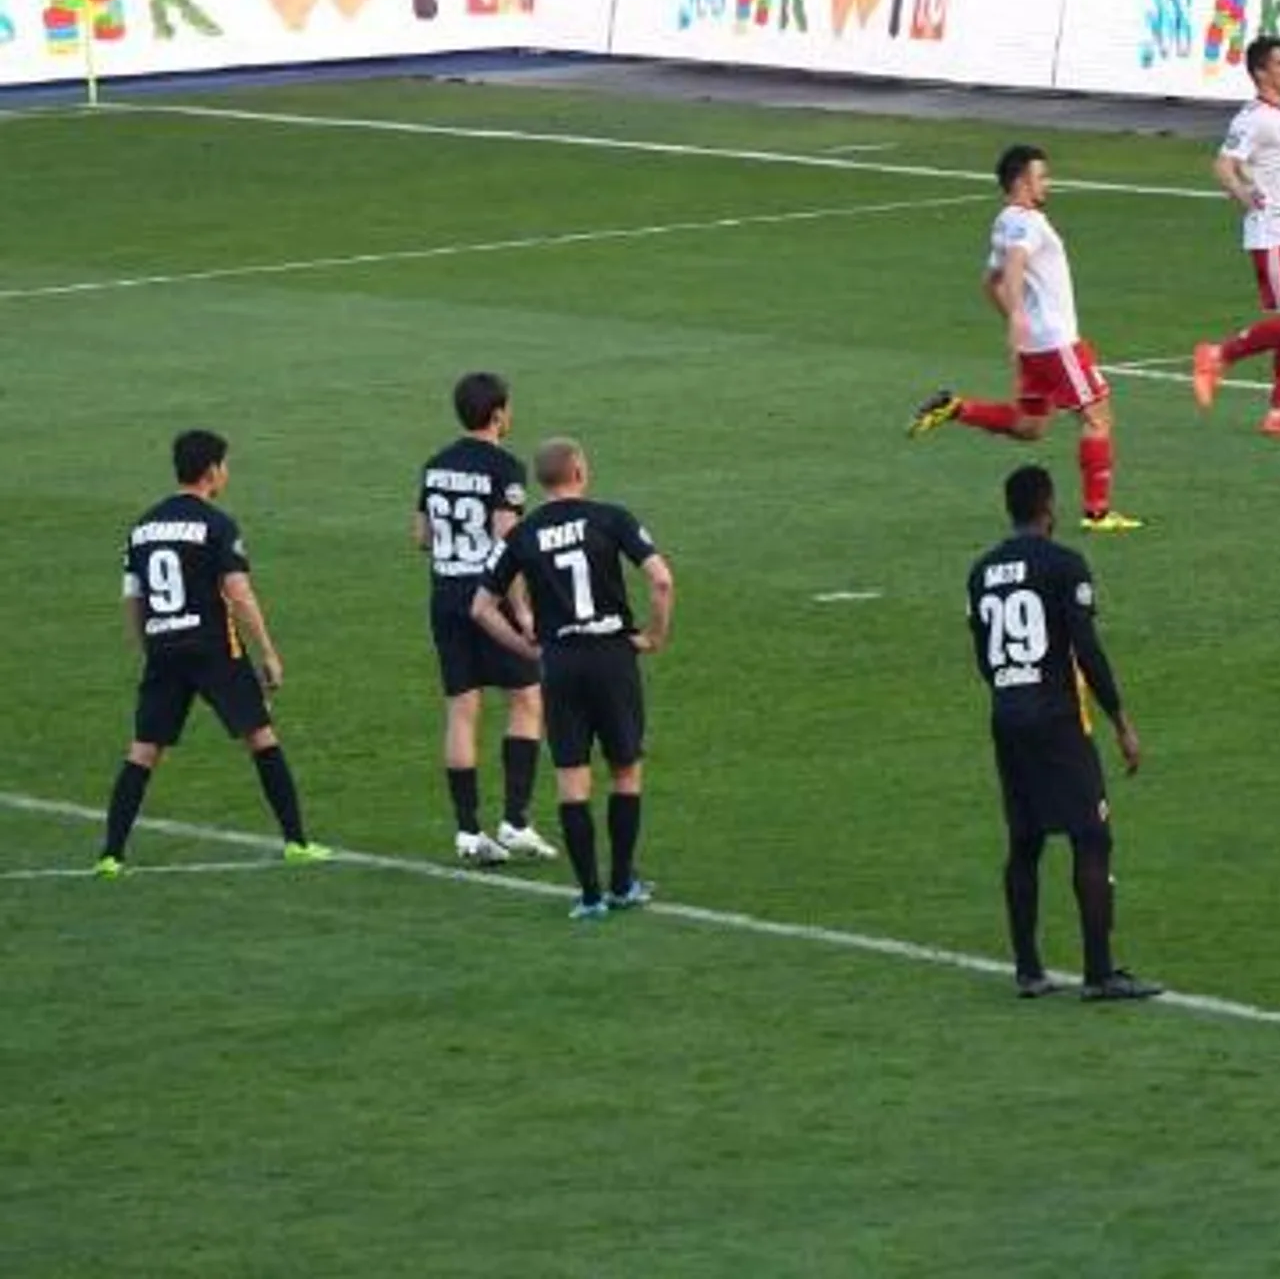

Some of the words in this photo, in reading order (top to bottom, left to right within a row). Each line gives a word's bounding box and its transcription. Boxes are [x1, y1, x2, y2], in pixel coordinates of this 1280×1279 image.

[427, 493, 492, 563] 63
[148, 549, 186, 612] 9
[554, 549, 595, 619] 7
